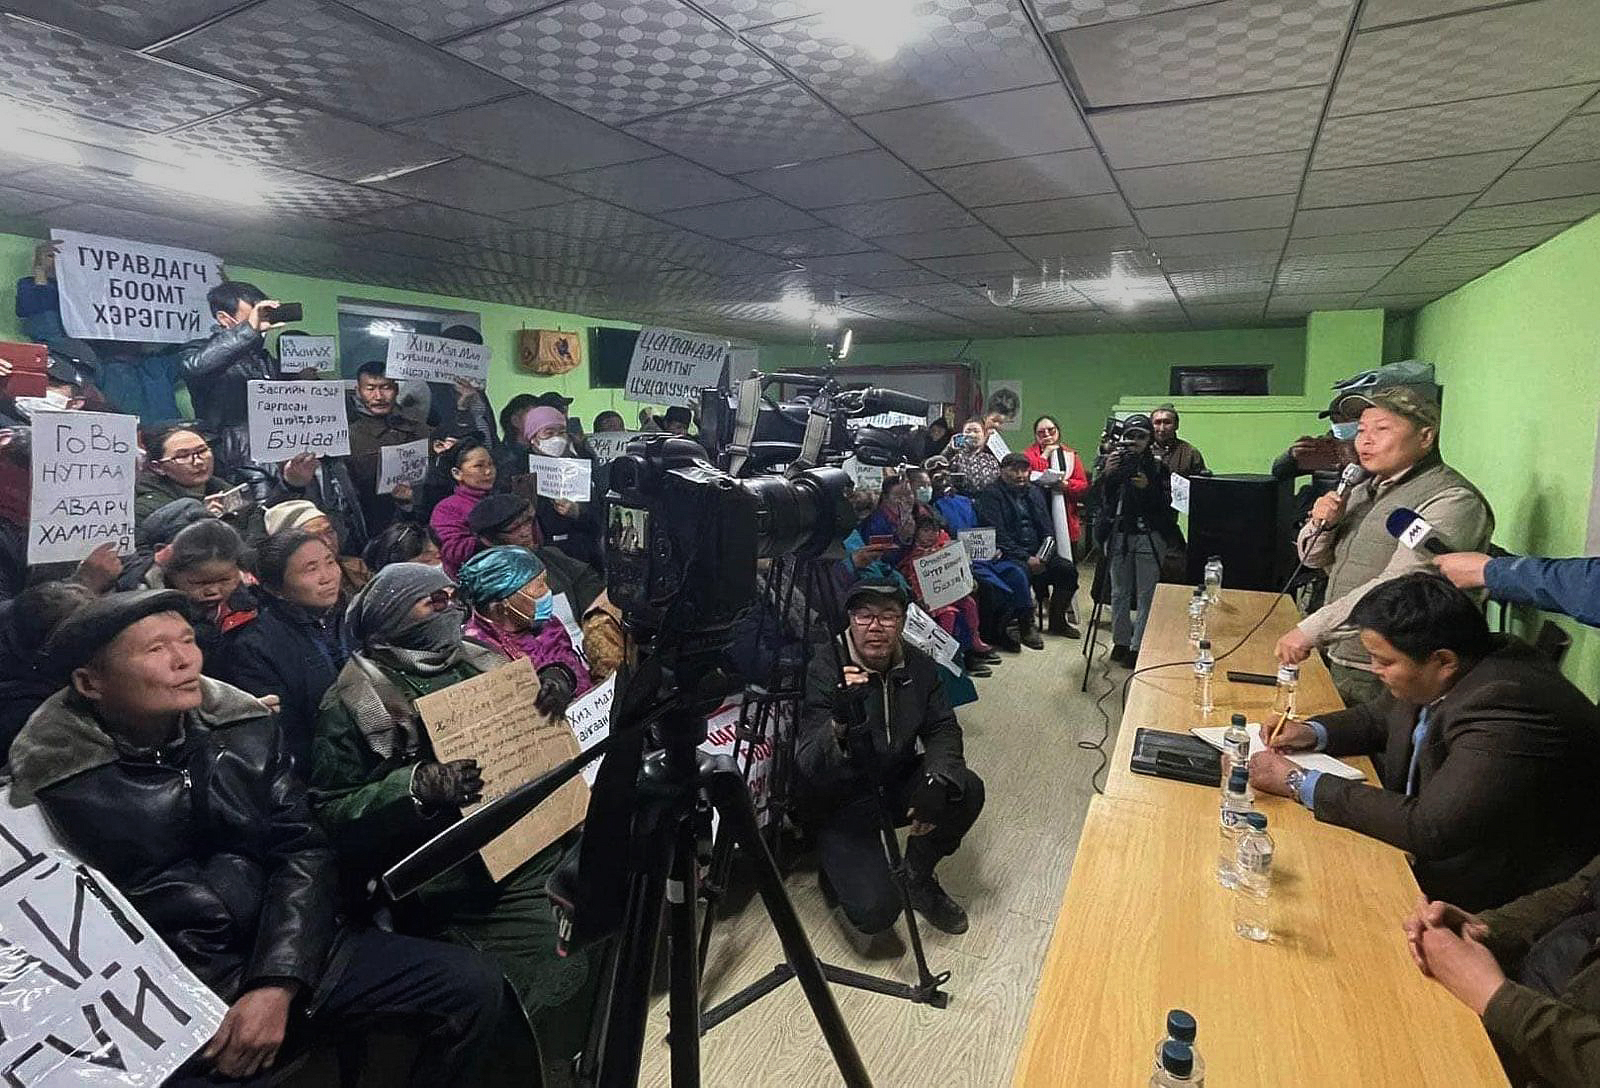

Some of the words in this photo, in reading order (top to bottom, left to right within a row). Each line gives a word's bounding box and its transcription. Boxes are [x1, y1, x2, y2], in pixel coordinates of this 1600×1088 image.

[78, 246, 207, 283] ГУРАВДАГЧ
[109, 278, 186, 305] БООМТ
[93, 303, 201, 333] ХЭРЭГГҮЙ
[641, 355, 696, 376] БООМТЫГ
[50, 500, 128, 517] АВАРЧ
